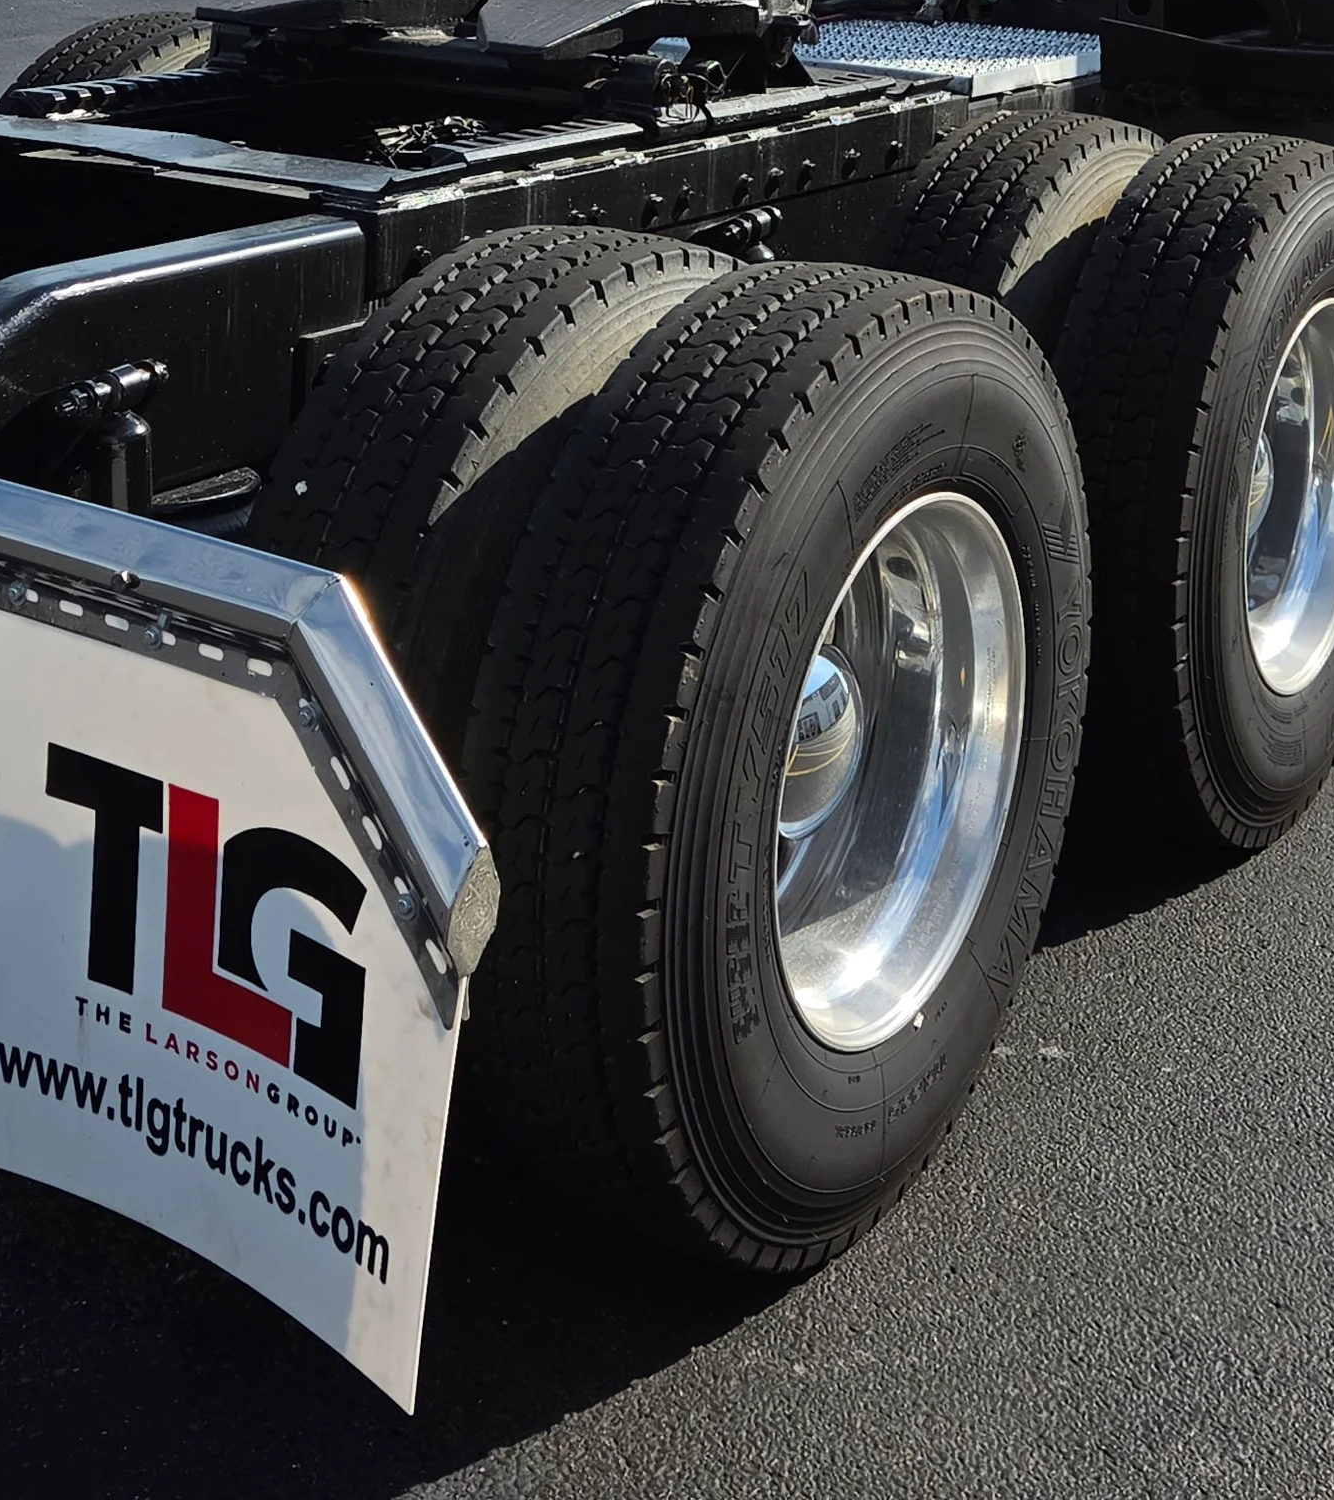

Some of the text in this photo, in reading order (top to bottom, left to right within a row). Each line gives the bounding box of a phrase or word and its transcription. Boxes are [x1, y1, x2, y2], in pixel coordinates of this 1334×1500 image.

[45, 742, 368, 1110] TLG
[987, 583, 1083, 990] YOKOHAMA
[75, 995, 132, 1034] THE
